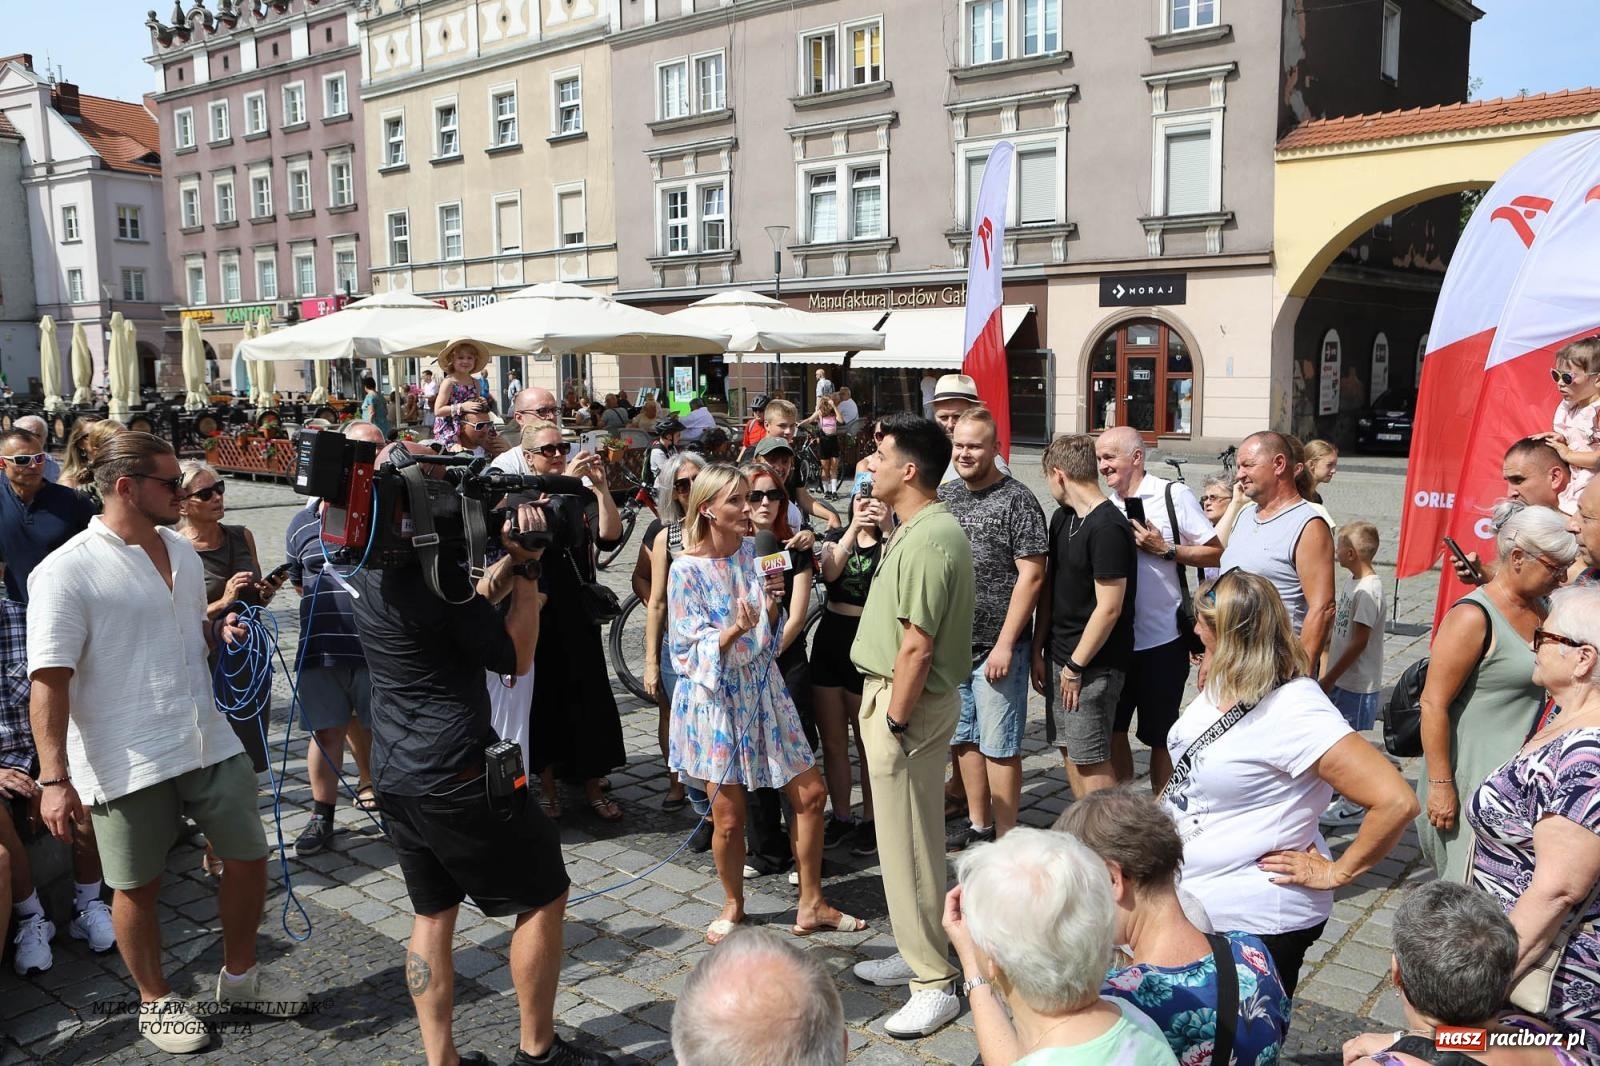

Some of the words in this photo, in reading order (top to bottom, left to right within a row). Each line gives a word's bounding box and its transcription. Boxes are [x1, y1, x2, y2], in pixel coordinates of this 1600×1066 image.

[808, 289, 886, 310] Manufaktura
[890, 287, 937, 307] Lodów
[941, 283, 967, 305] Gał
[1129, 286, 1173, 295] MORAJ
[225, 306, 272, 323] KANTOR
[1414, 491, 1456, 509] ORLE
[1221, 704, 1245, 729] 1980
